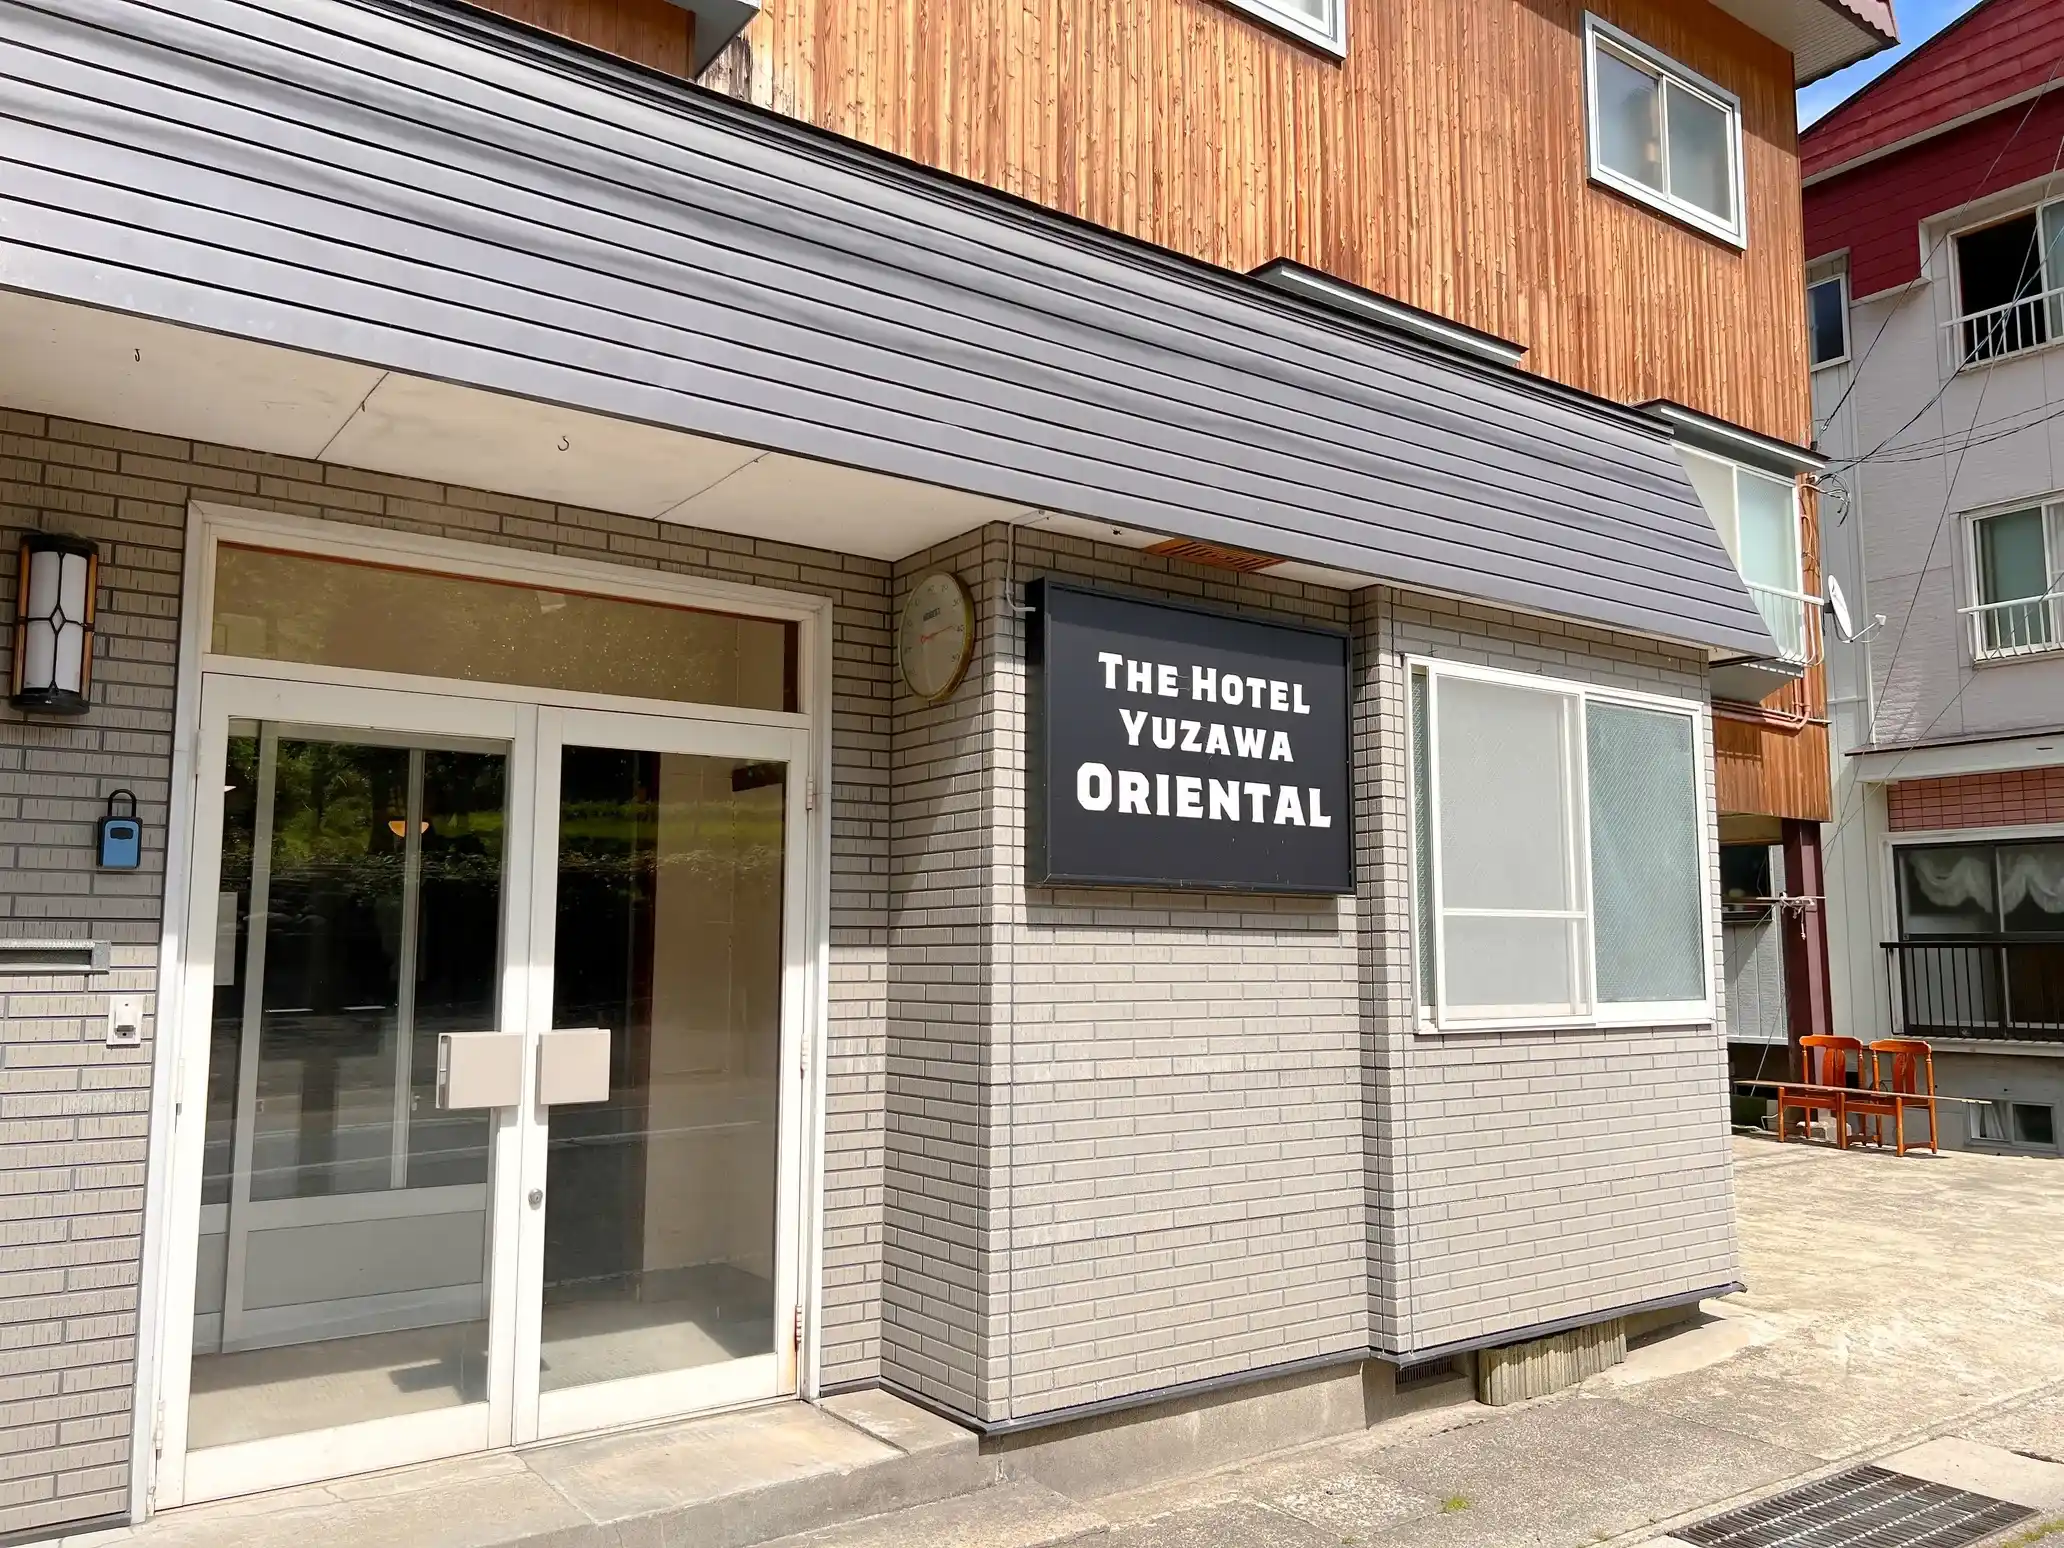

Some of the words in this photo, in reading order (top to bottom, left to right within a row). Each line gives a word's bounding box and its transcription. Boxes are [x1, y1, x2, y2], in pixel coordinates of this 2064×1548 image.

[1097, 651, 1180, 698] THE
[1191, 665, 1311, 715] HOTEL
[1118, 708, 1294, 763] YUZAWA
[1076, 761, 1332, 828] ORIENTAL
